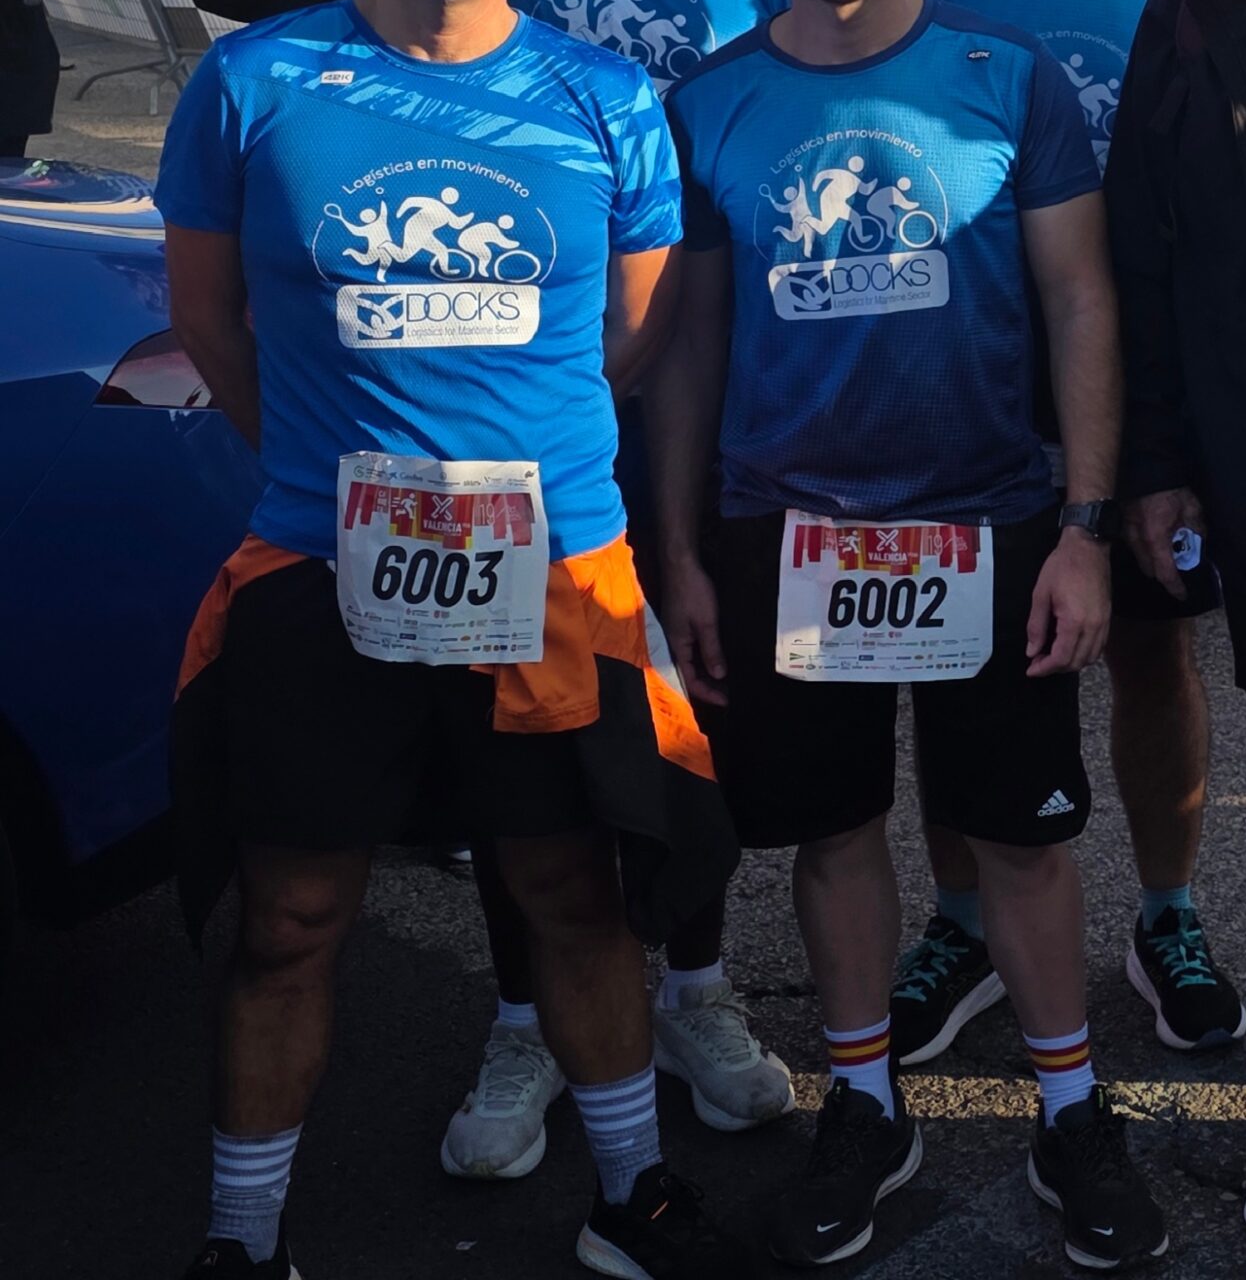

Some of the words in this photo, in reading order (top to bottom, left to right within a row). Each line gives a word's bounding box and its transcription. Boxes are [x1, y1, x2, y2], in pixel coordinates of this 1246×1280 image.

[770, 137, 824, 174] Logística
[826, 130, 843, 142] en
[845, 128, 923, 157] movimiento
[342, 161, 413, 195] Logística
[417, 158, 437, 169] en
[441, 158, 530, 198] movimiento
[830, 258, 931, 294] DOCKS
[406, 291, 520, 322] DOCKS
[423, 520, 463, 533] VALENCIA
[372, 545, 504, 608] 6003
[868, 552, 908, 563] VALENCIA
[828, 576, 947, 629] 6002
